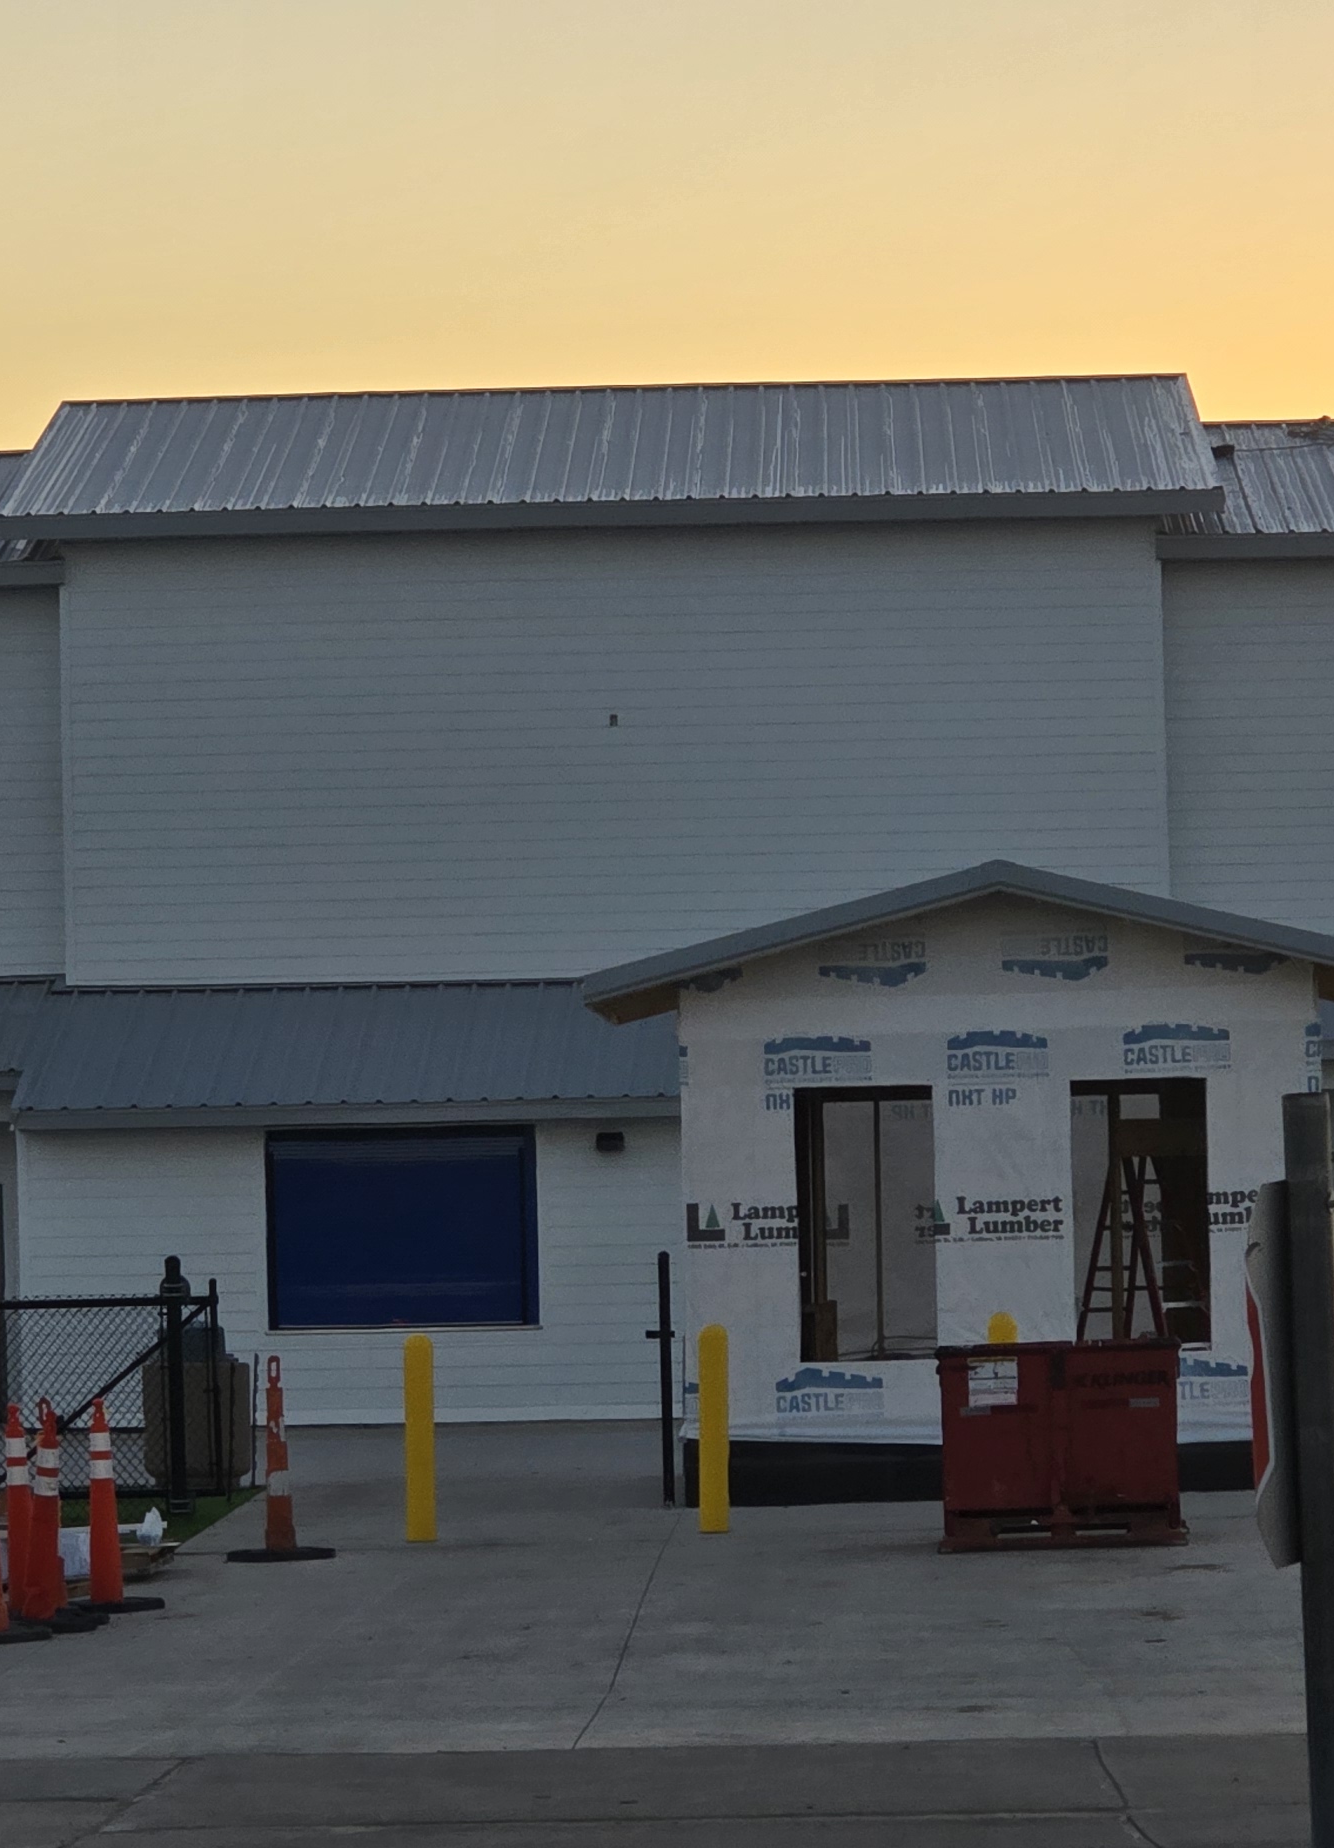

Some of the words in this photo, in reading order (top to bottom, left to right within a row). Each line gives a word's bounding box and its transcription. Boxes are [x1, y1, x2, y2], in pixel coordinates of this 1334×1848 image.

[992, 1088, 1016, 1106] HP
[731, 1203, 798, 1223] Lamp
[956, 1196, 1063, 1217] Lampert
[742, 1222, 798, 1241] Lum
[967, 1215, 1064, 1235] Lumber
